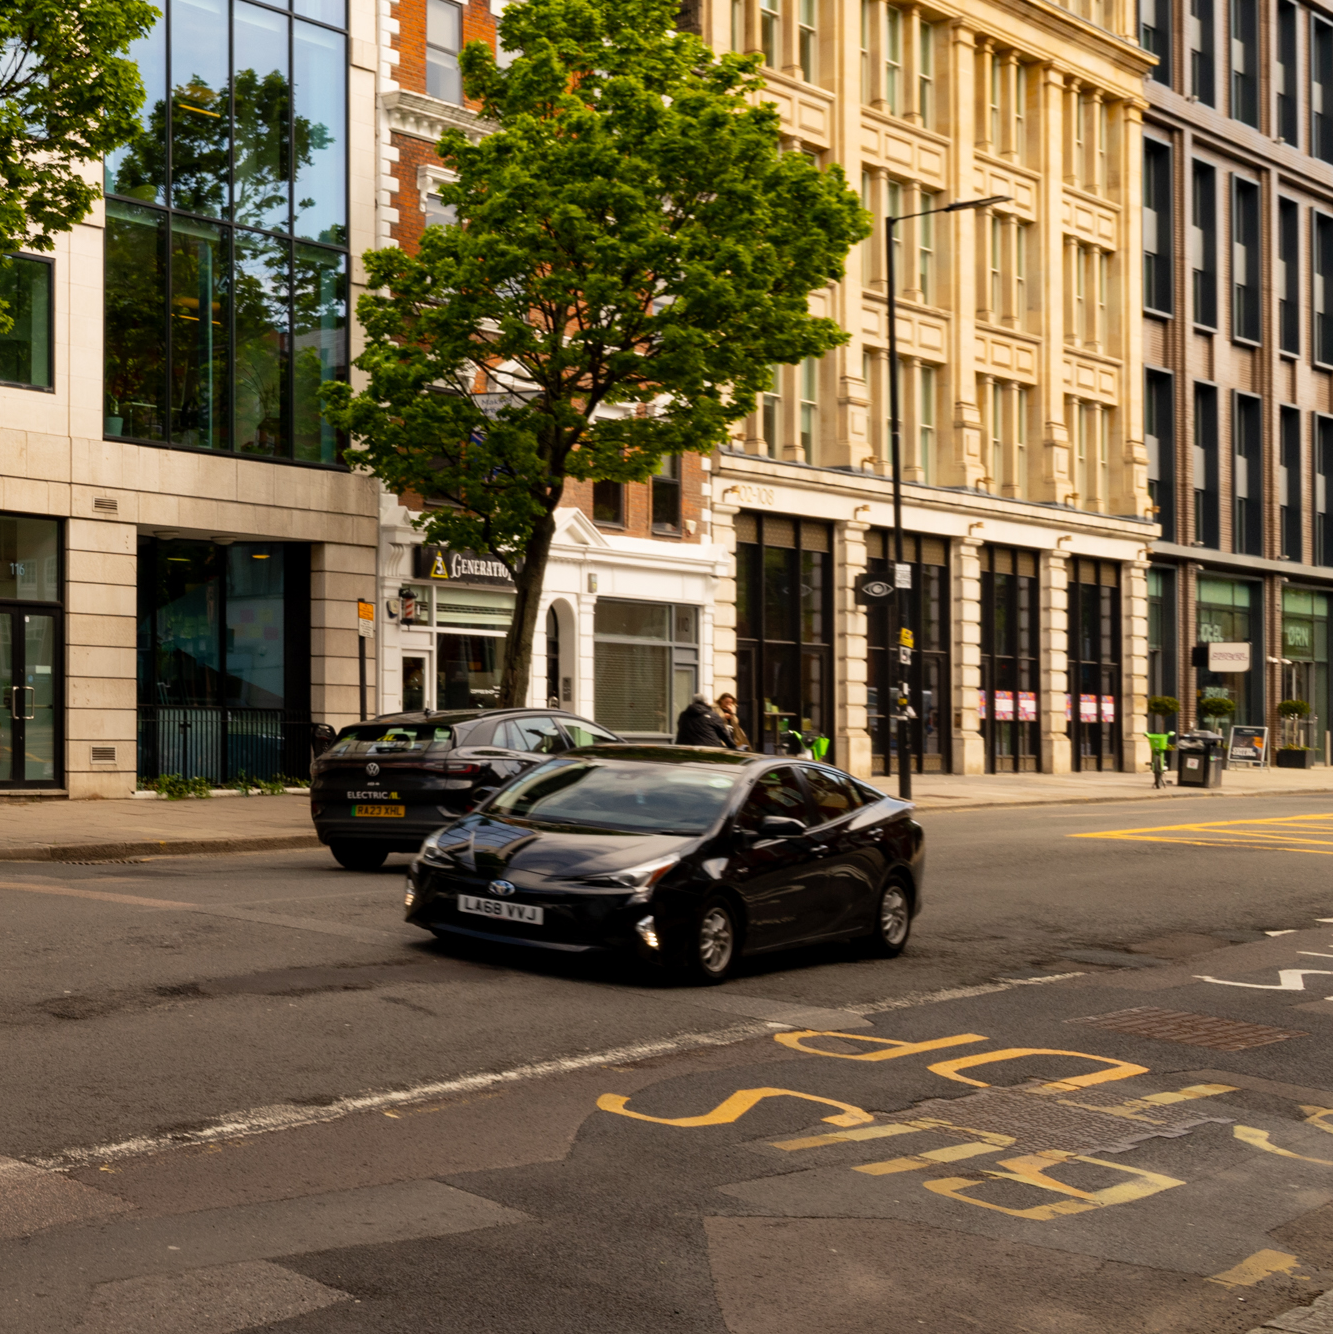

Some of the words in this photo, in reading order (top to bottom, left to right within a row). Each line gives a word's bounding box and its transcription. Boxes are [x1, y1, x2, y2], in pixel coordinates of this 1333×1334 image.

[9, 562, 26, 576] 116
[435, 555, 446, 575] 3
[347, 791, 388, 799] ELECTRIC
[357, 805, 381, 815] RA23
[383, 806, 403, 816] XHL
[464, 897, 502, 915] LA68
[506, 904, 537, 921] VVJ
